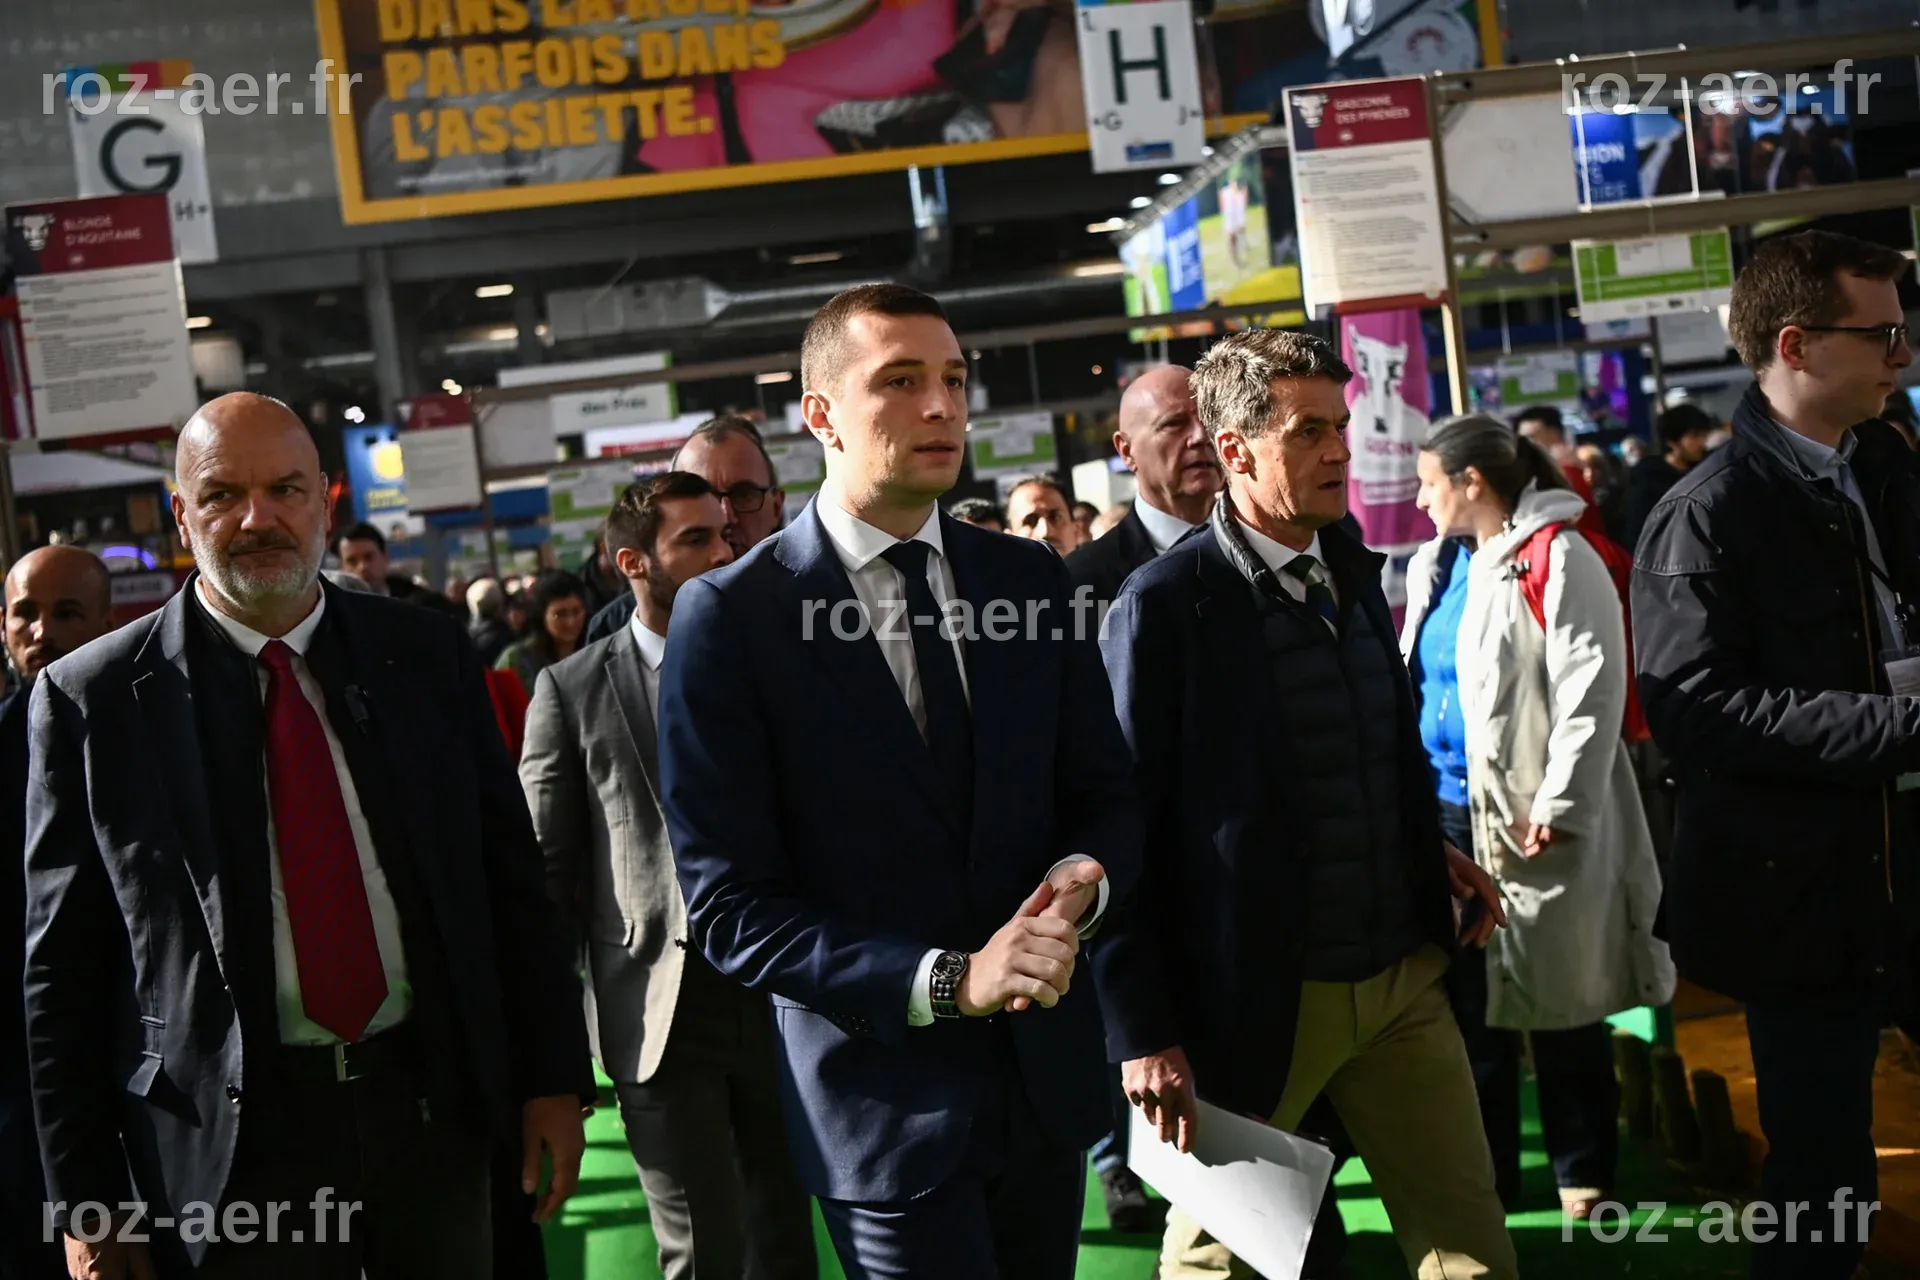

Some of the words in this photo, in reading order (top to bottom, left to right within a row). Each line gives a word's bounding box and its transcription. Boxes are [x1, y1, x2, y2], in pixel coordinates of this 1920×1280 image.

[378, 0, 529, 41] DANS
[384, 35, 629, 101] PARFOIS
[637, 20, 787, 79] DANS
[1108, 24, 1173, 106] H
[100, 117, 183, 193] G
